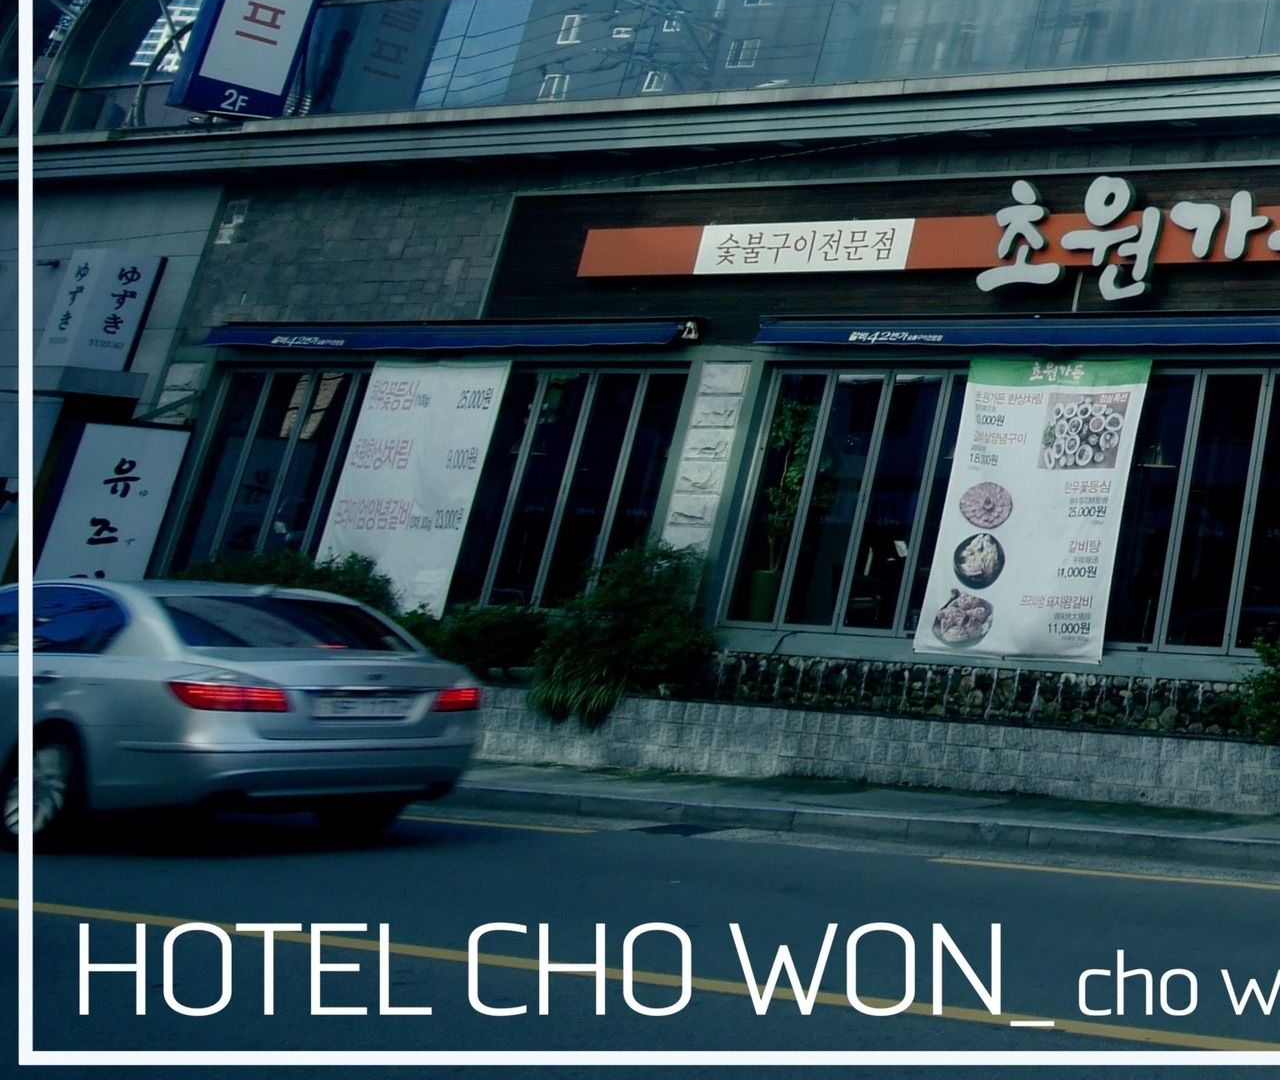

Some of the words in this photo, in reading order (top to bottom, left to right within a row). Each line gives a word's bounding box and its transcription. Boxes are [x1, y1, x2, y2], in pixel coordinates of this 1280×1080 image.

[219, 88, 249, 111] 2F
[715, 226, 897, 267] 숯불구이전문점
[104, 265, 142, 335] ゆずき
[1028, 361, 1086, 382] 초원가든
[69, 457, 141, 580] 유즈
[1069, 539, 1102, 554] 갈비탕
[1047, 621, 1091, 636] 11,000원
